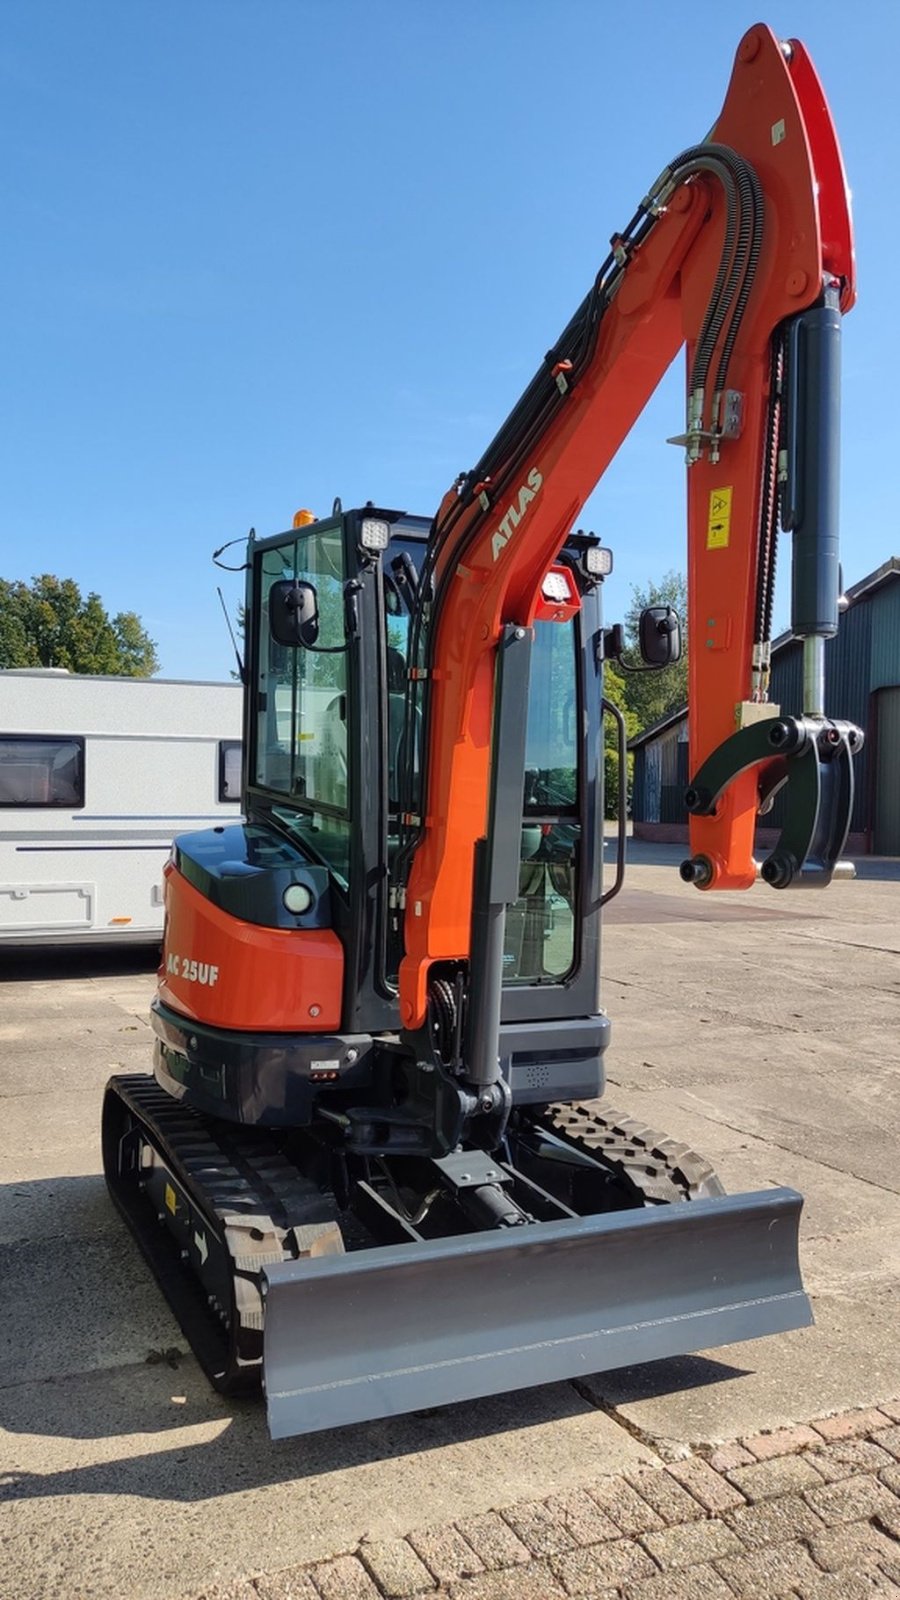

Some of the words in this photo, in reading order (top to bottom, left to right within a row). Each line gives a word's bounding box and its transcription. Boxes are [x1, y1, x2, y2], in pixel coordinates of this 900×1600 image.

[491, 467, 543, 562] ATLAS
[166, 953, 179, 975] AC
[181, 958, 219, 987] 25UF
